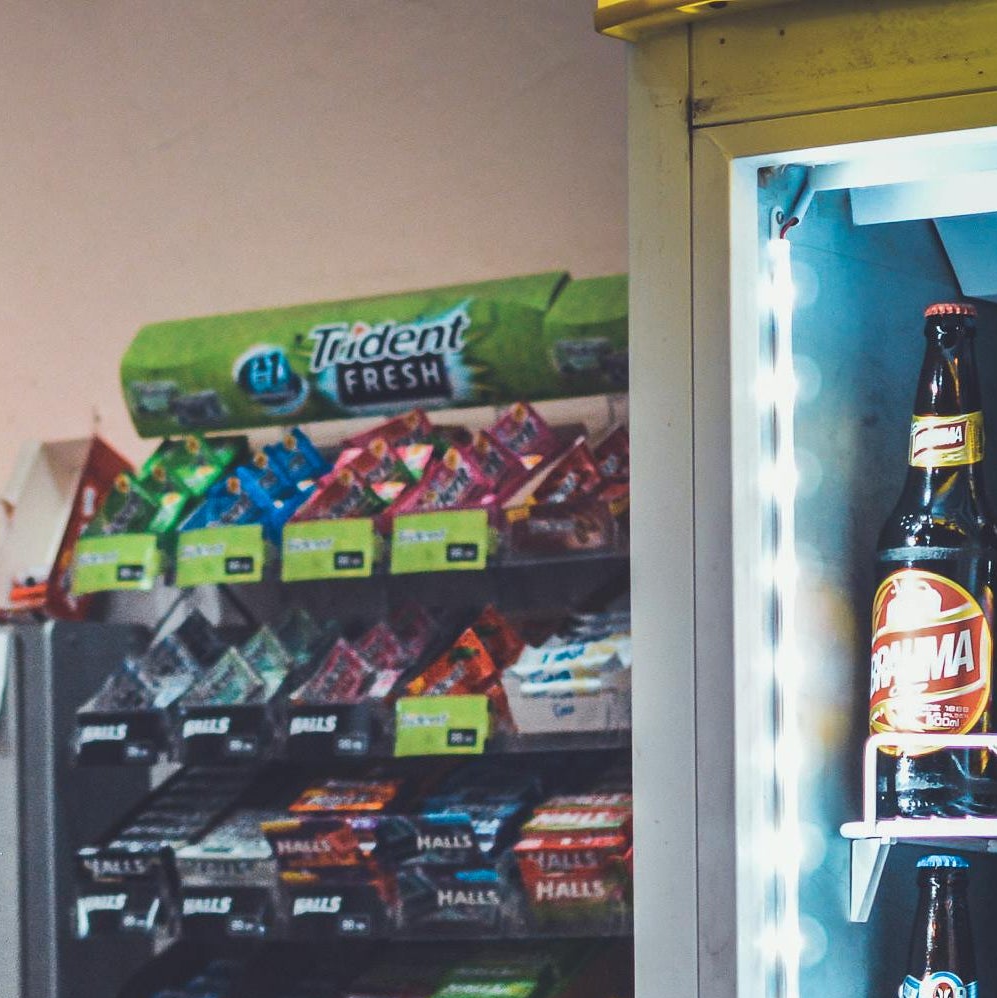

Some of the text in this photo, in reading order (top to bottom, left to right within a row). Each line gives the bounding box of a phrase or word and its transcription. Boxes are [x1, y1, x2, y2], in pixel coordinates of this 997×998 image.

[310, 313, 467, 372] Trident
[344, 360, 442, 396] FRESH
[870, 628, 975, 699] BRAMA
[928, 716, 960, 727] 00ml
[277, 838, 333, 856] HALLS
[417, 834, 473, 850] HALLS
[437, 889, 500, 906] HALLS
[536, 879, 605, 900] HALLS
